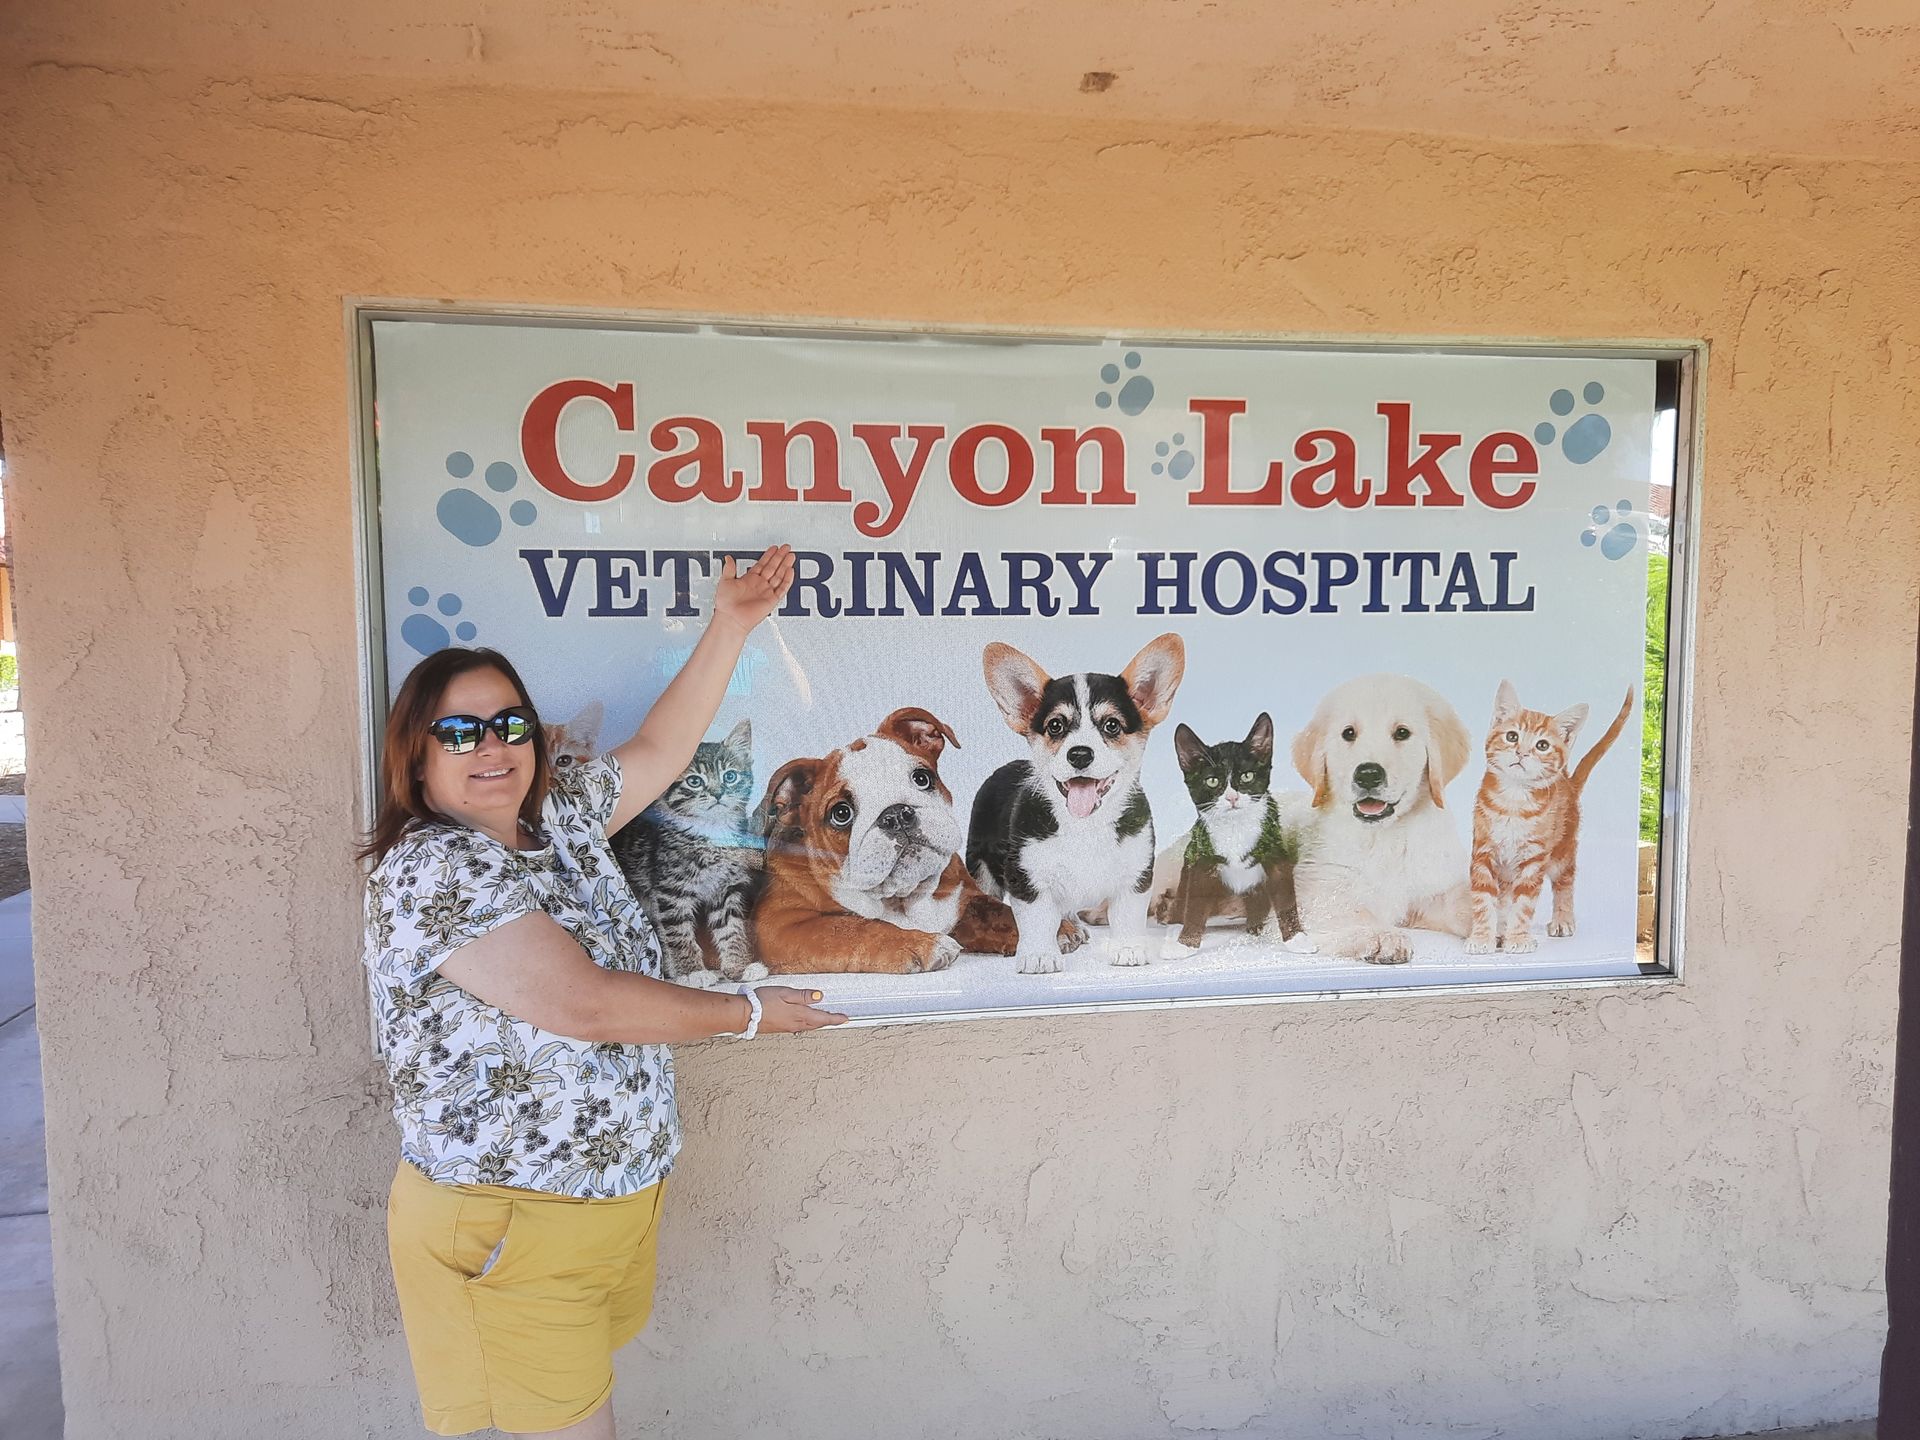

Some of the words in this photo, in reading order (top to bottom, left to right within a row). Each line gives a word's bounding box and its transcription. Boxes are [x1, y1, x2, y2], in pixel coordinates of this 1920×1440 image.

[520, 379, 1136, 537] Canyon
[1188, 398, 1538, 510] Lake
[1137, 550, 1535, 615] HOSPITAL
